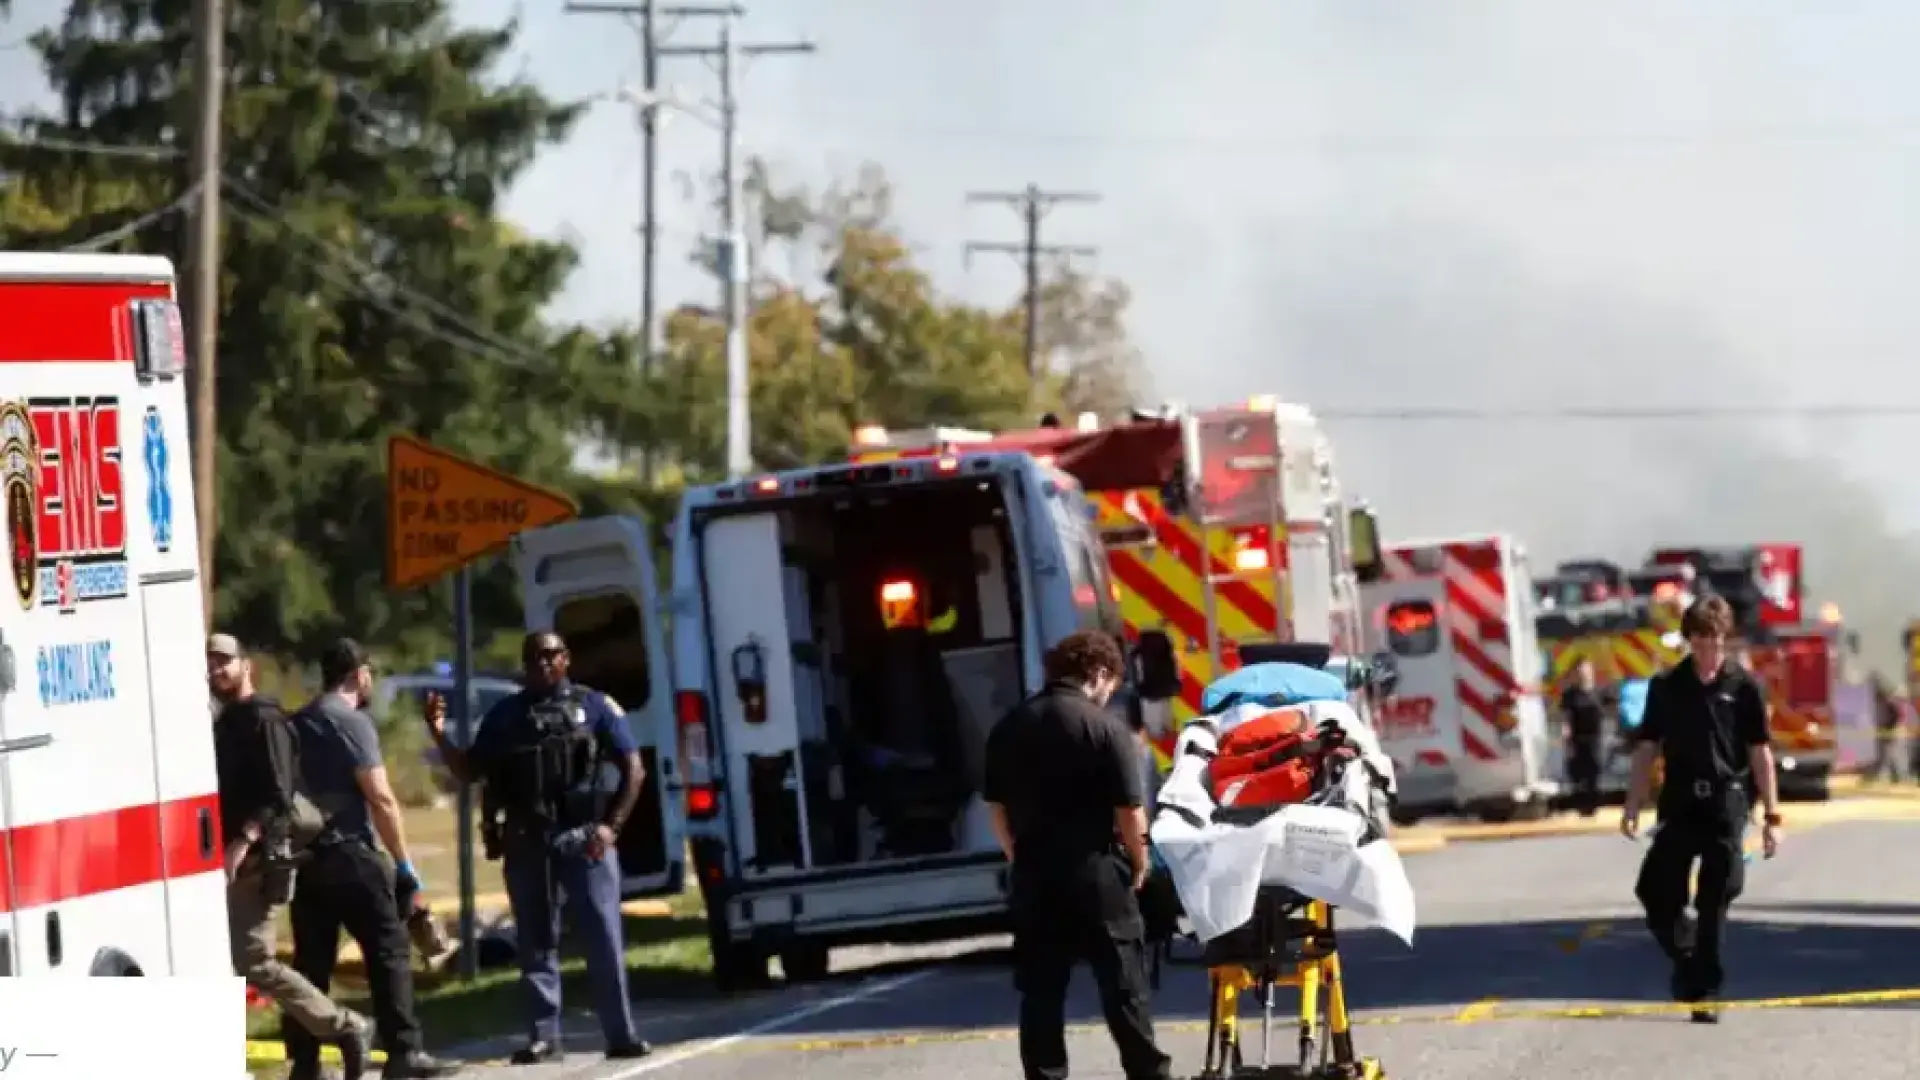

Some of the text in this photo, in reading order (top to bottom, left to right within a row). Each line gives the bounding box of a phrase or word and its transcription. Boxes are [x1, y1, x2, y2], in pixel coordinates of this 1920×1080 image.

[28, 397, 127, 562] EMS
[399, 466, 440, 492] NO
[400, 498, 528, 524] PASSING
